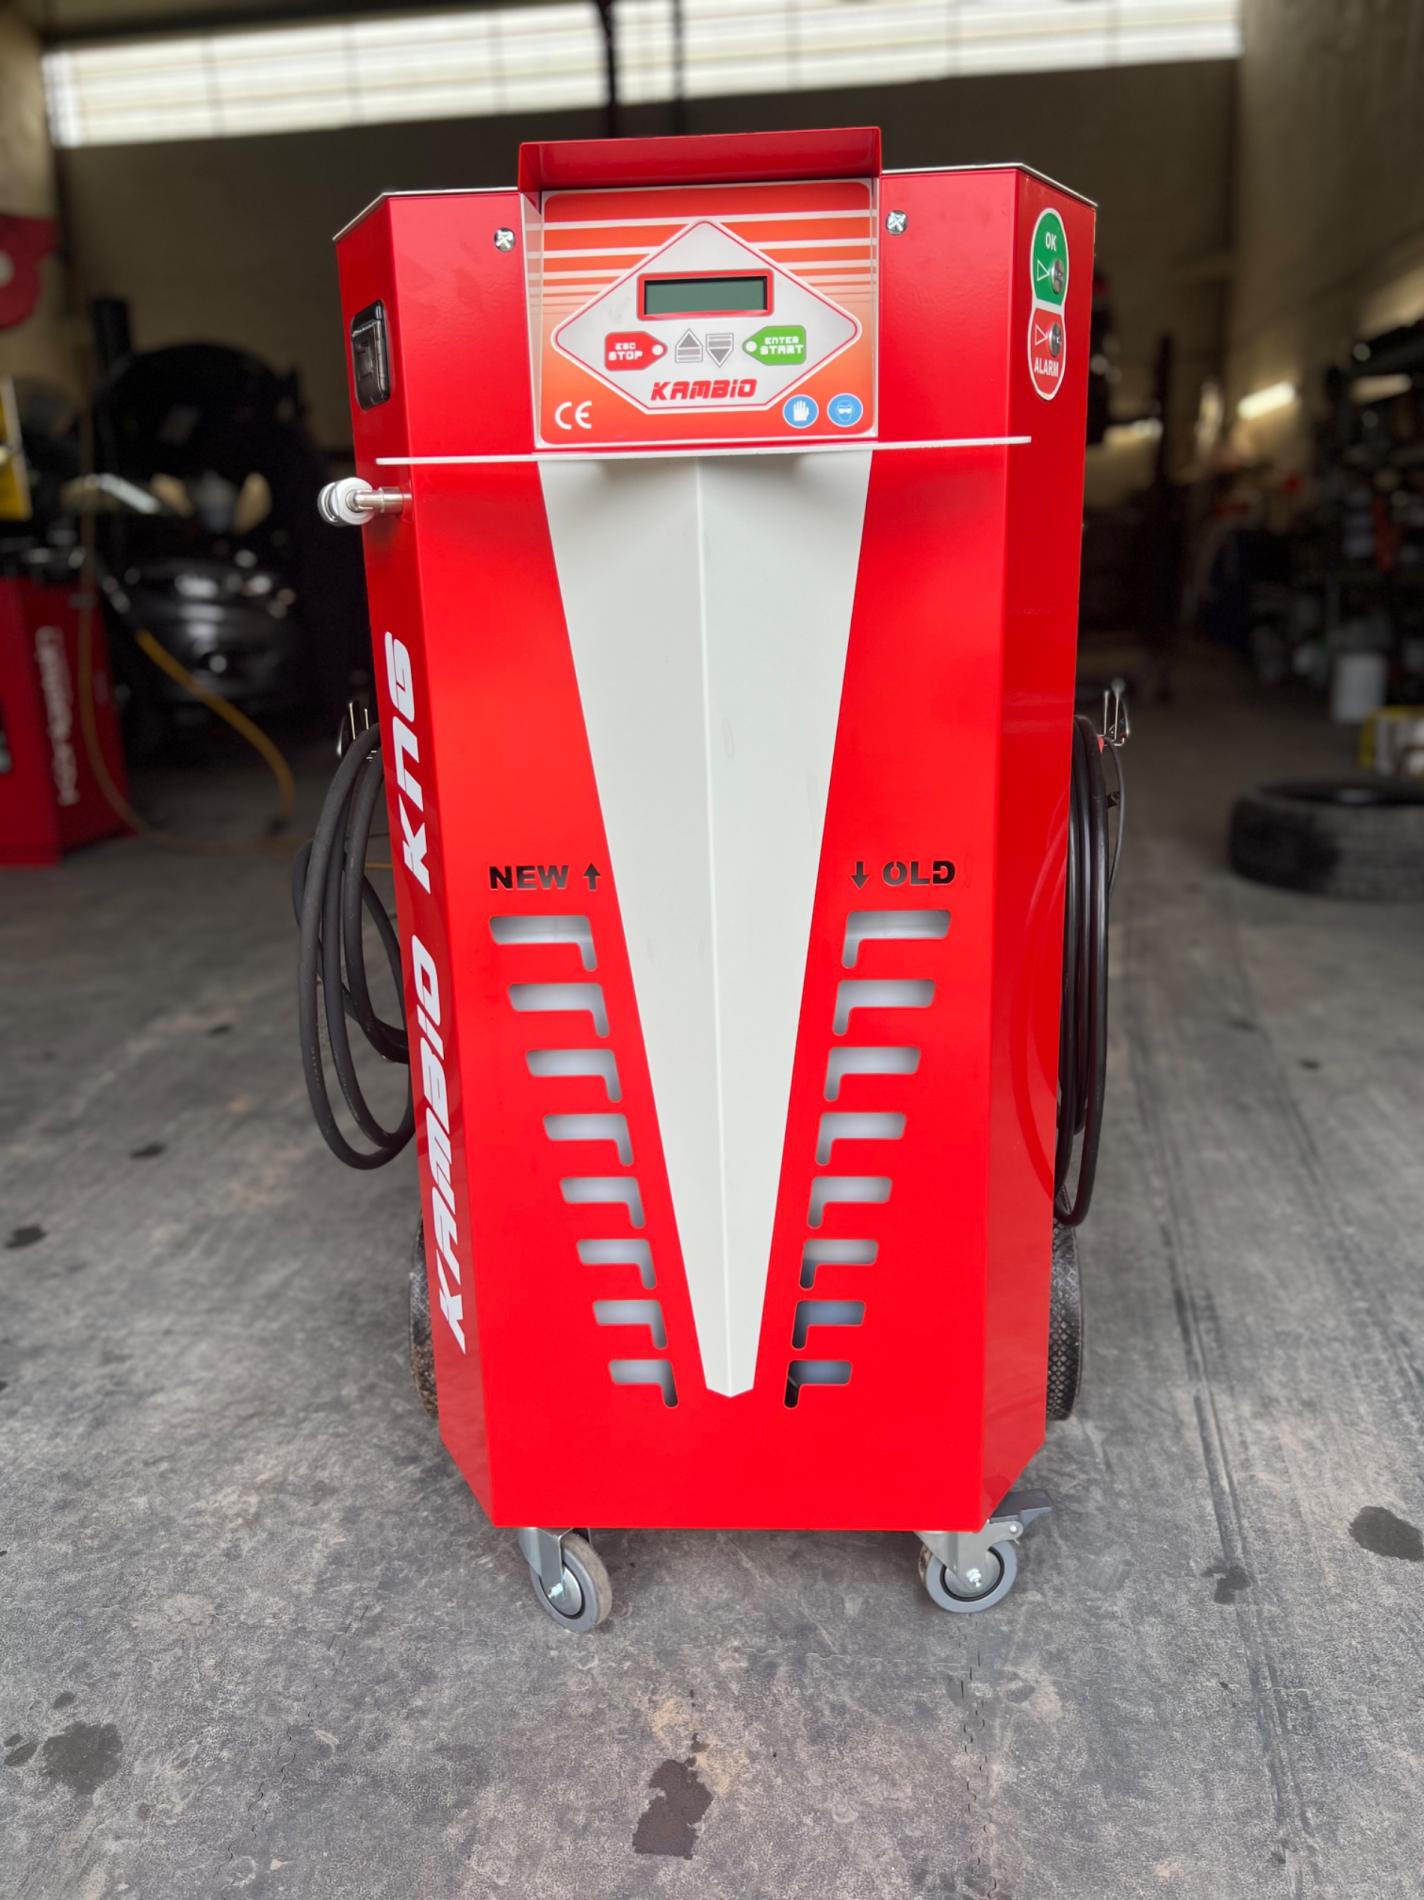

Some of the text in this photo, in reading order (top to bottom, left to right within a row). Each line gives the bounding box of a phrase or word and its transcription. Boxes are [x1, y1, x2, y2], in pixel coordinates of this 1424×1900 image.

[1045, 231, 1057, 251] OK
[614, 341, 636, 351] ESC
[760, 343, 804, 356] START
[765, 335, 799, 345] ENTER
[608, 350, 643, 361] STOP
[1034, 357, 1059, 377] ALARM
[651, 379, 757, 400] KAMBIO
[489, 865, 568, 890] NEW
[883, 861, 956, 885] OLD
[384, 631, 466, 1355] KAMBIO KNG
